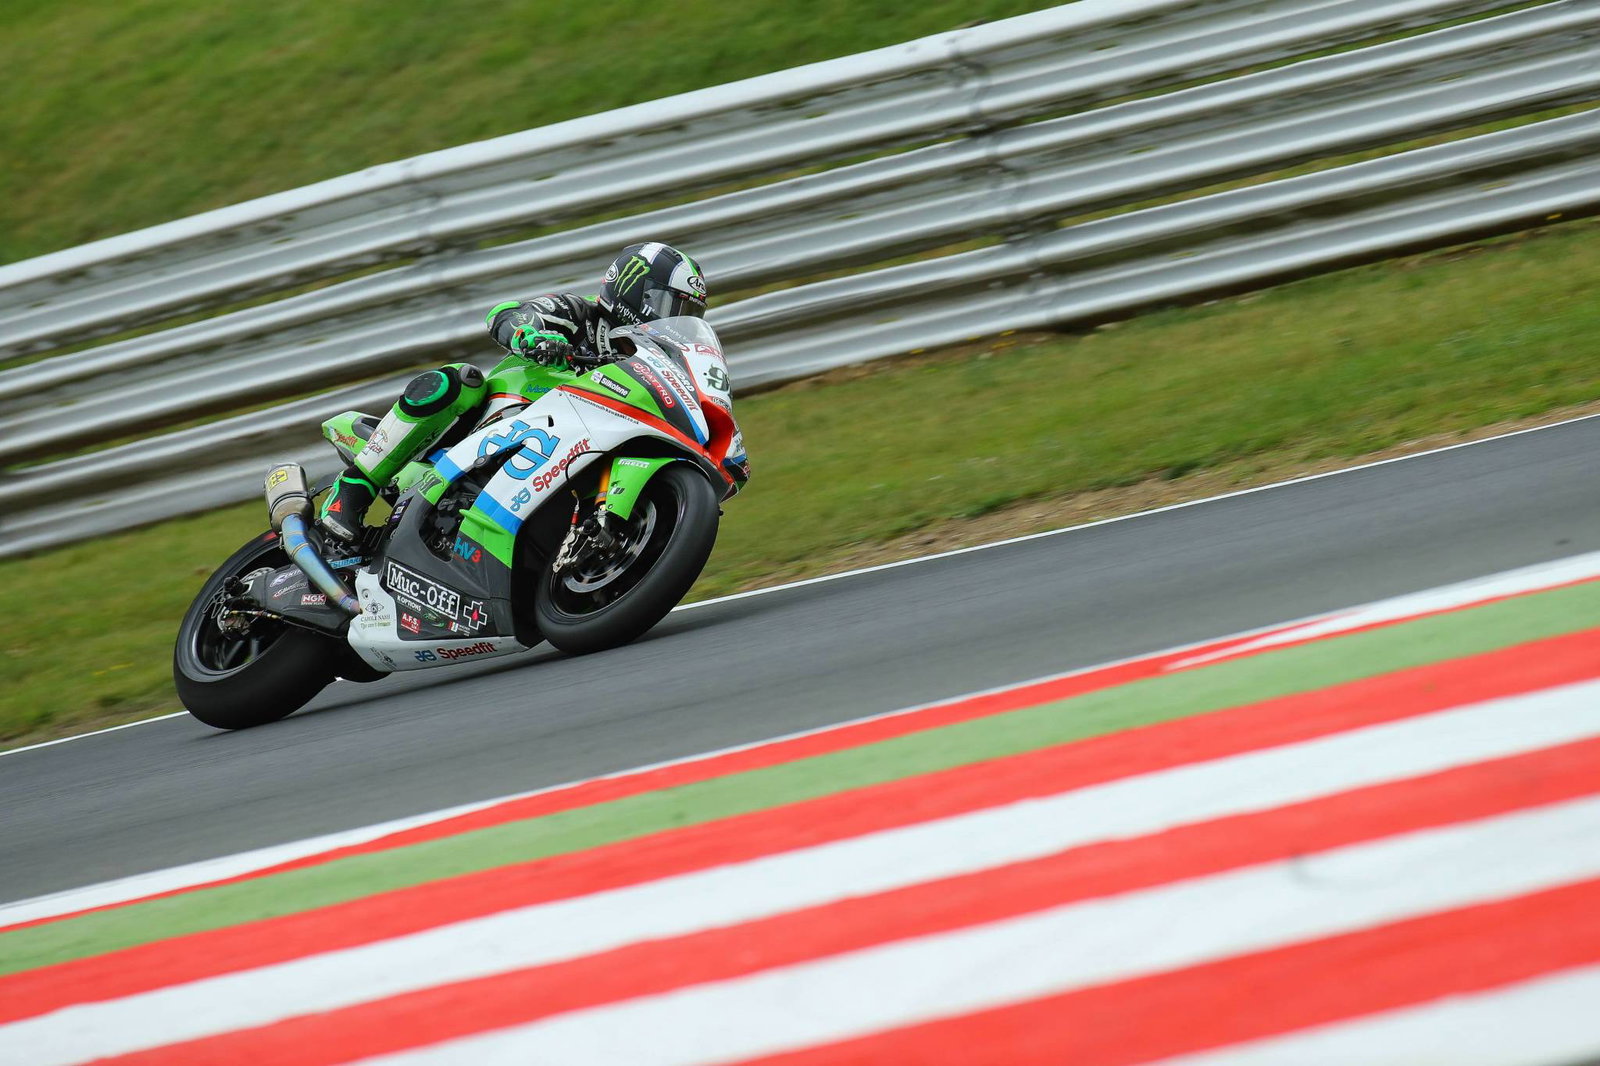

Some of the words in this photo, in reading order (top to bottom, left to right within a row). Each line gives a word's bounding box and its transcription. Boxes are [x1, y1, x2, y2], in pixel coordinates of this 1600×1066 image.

[616, 302, 642, 329] MONS
[600, 377, 629, 397] Silkolene
[632, 362, 674, 405] QUATTRO
[661, 369, 699, 411] Speedfit
[532, 438, 592, 492] Speedfit
[453, 536, 483, 563] HV3
[303, 594, 326, 602] NGK
[390, 567, 457, 616] Muc-Off
[436, 641, 497, 661] Speedfit
